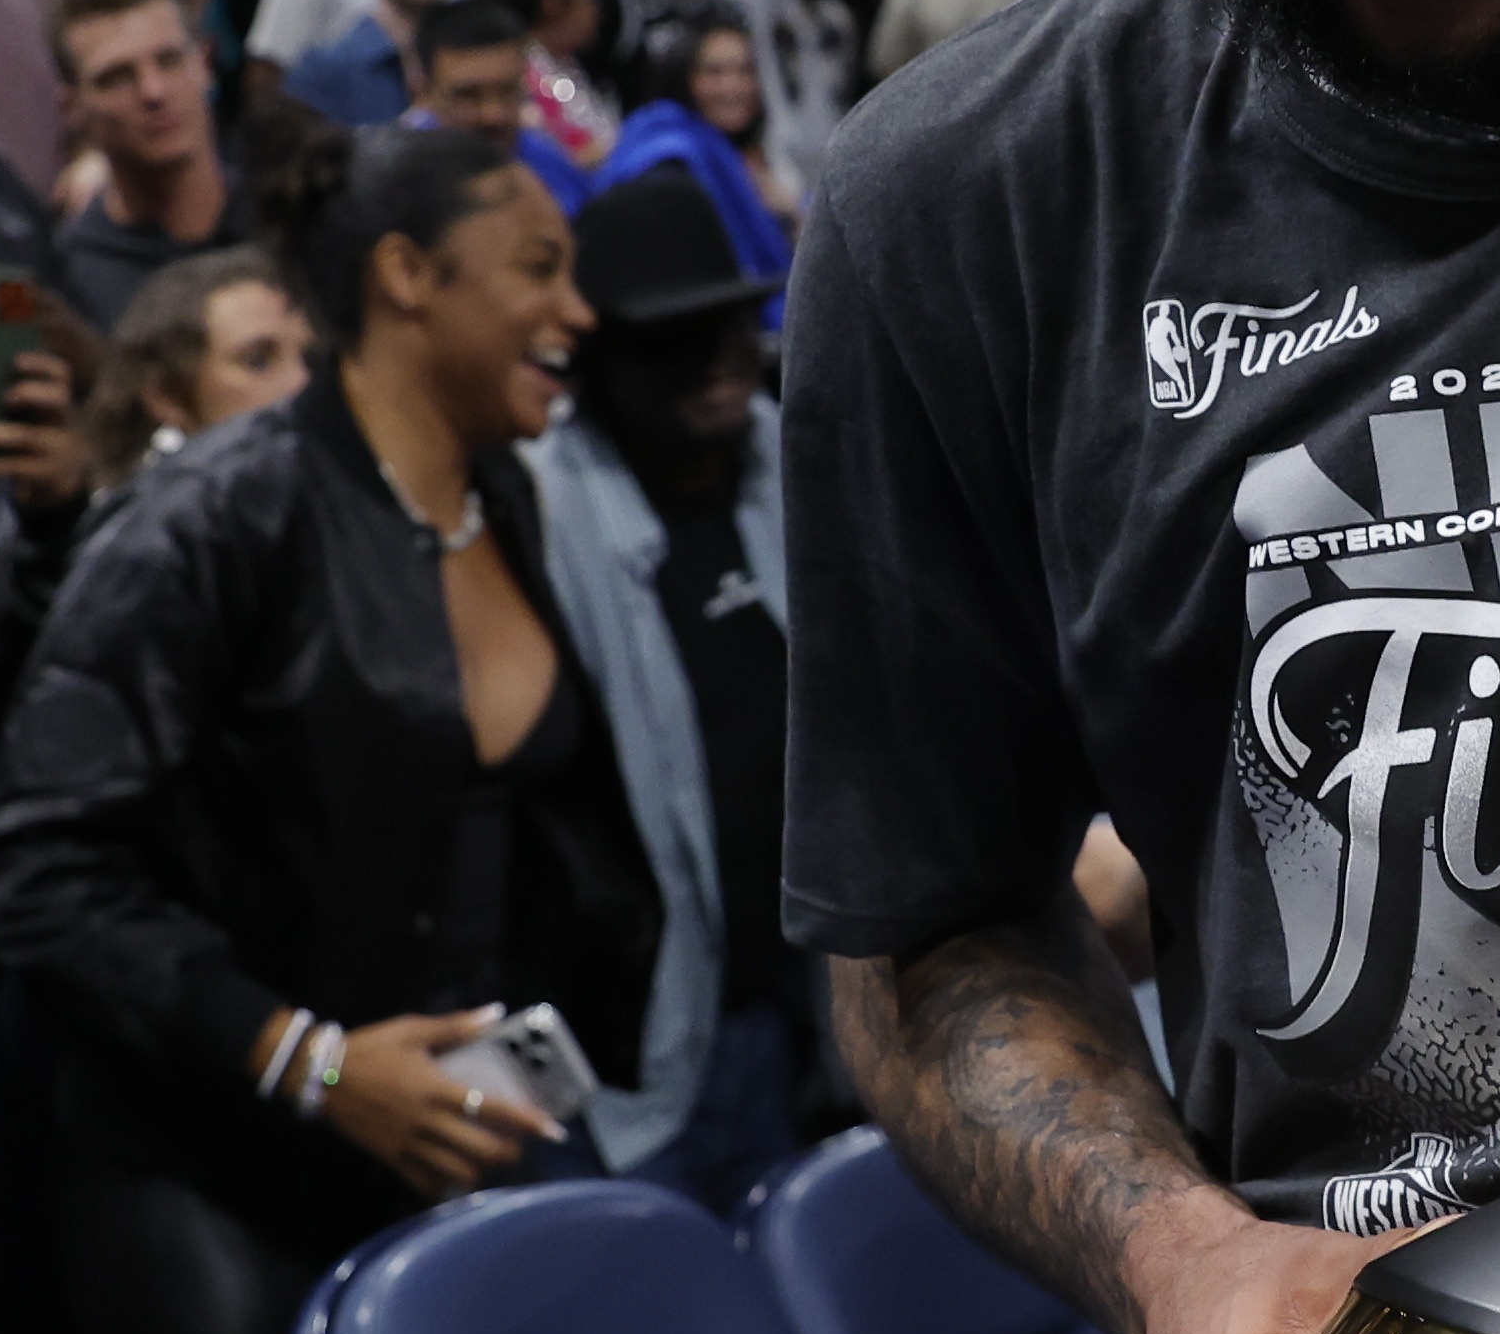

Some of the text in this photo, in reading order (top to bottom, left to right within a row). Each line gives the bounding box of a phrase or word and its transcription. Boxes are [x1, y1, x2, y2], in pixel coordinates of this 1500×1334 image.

[1173, 285, 1380, 419] Finals
[1155, 380, 1179, 401] NBA
[1248, 518, 1425, 569] WESTERN
[1415, 1138, 1446, 1168] NBA
[1333, 1178, 1462, 1238] WESTE
